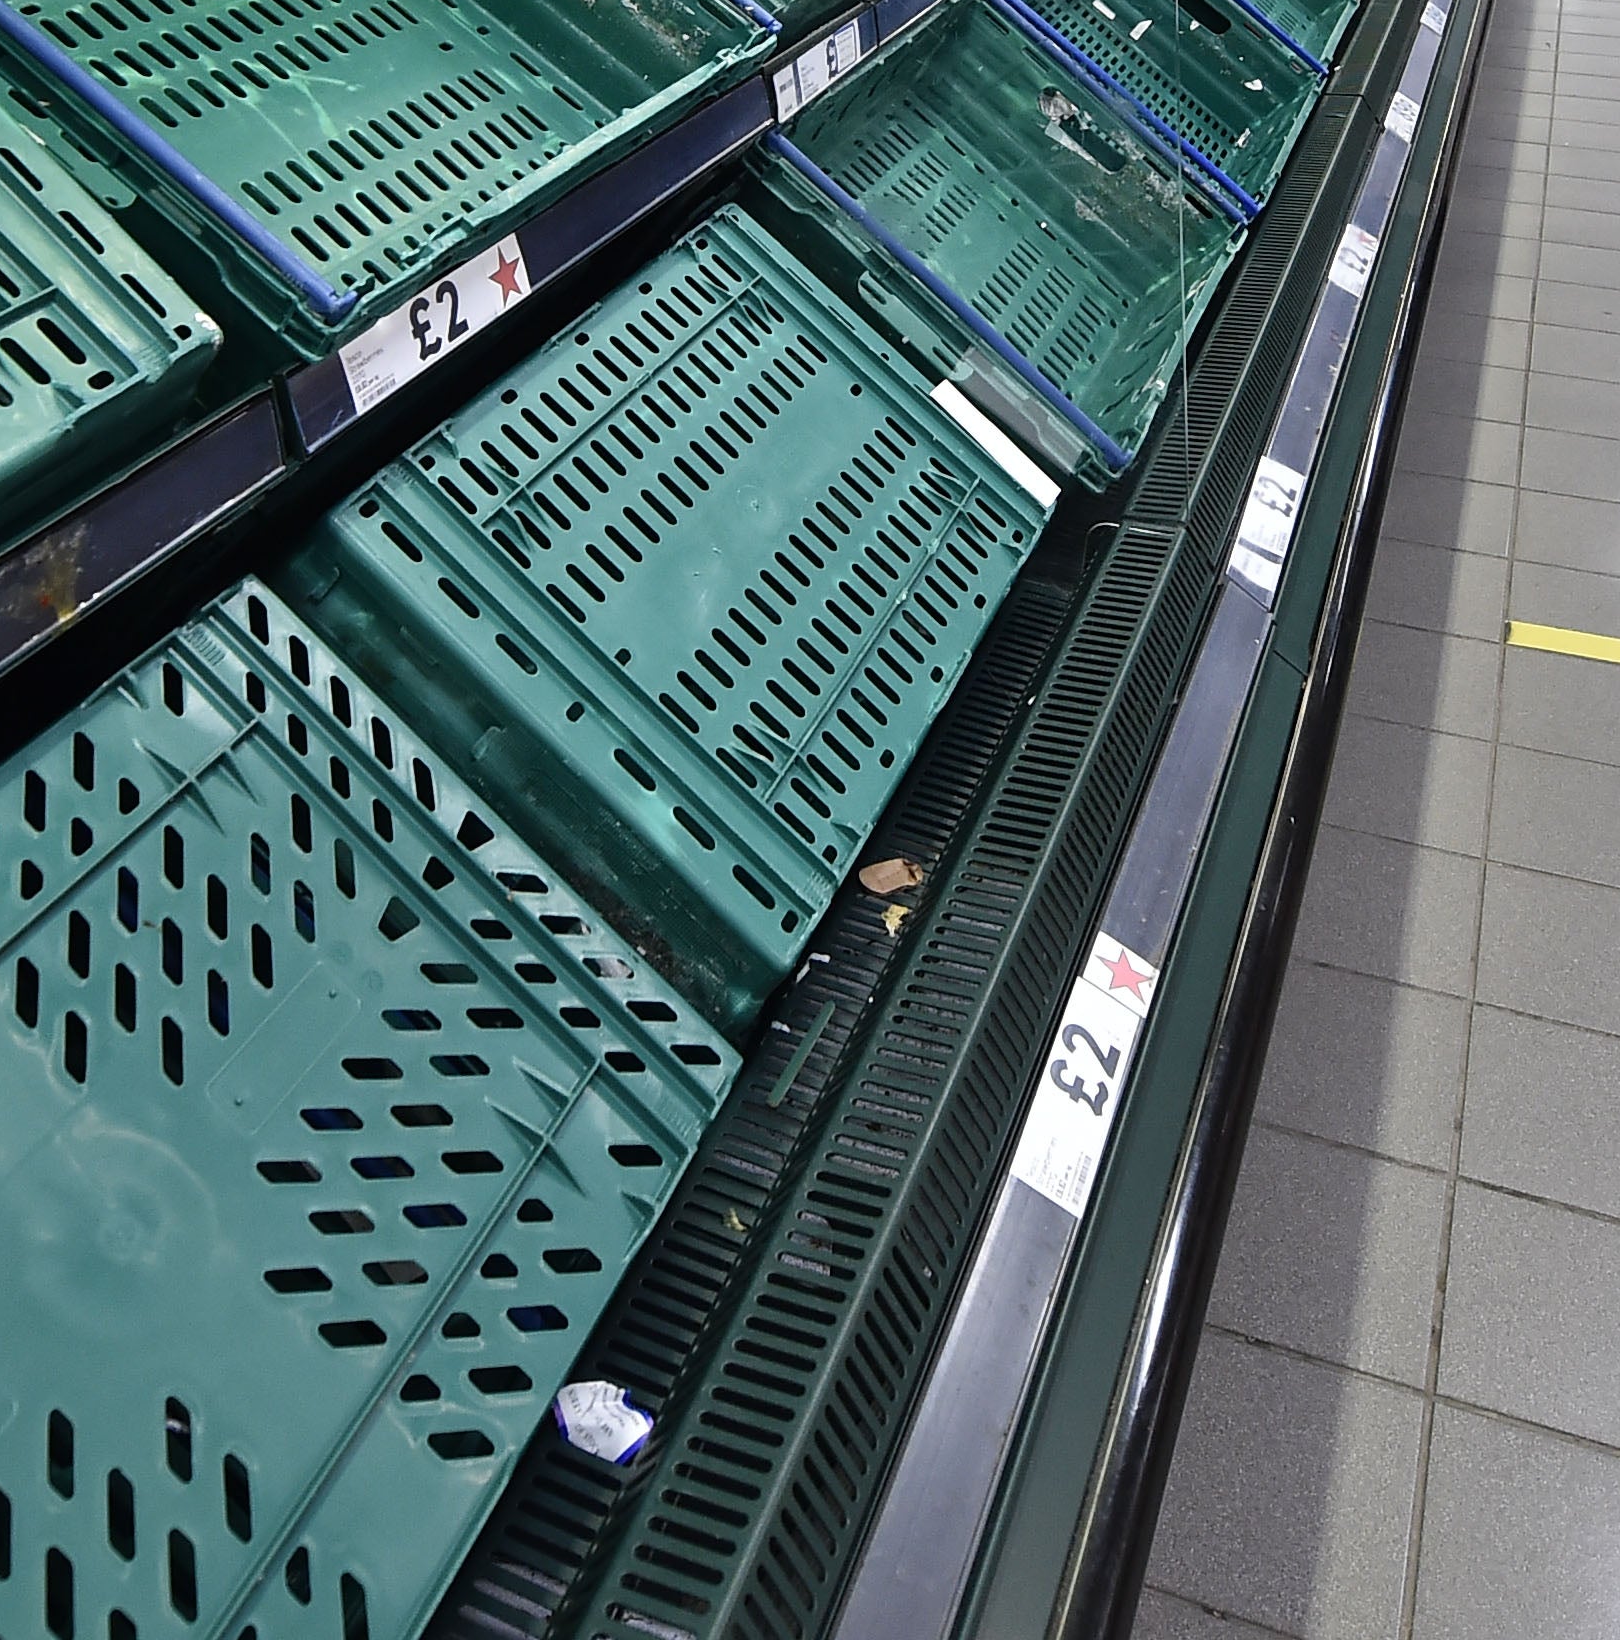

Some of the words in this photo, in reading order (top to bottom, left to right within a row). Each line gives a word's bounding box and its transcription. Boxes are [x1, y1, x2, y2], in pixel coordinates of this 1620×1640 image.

[408, 279, 470, 362] £2
[1252, 474, 1298, 519] £2
[1049, 1022, 1122, 1117] £2
